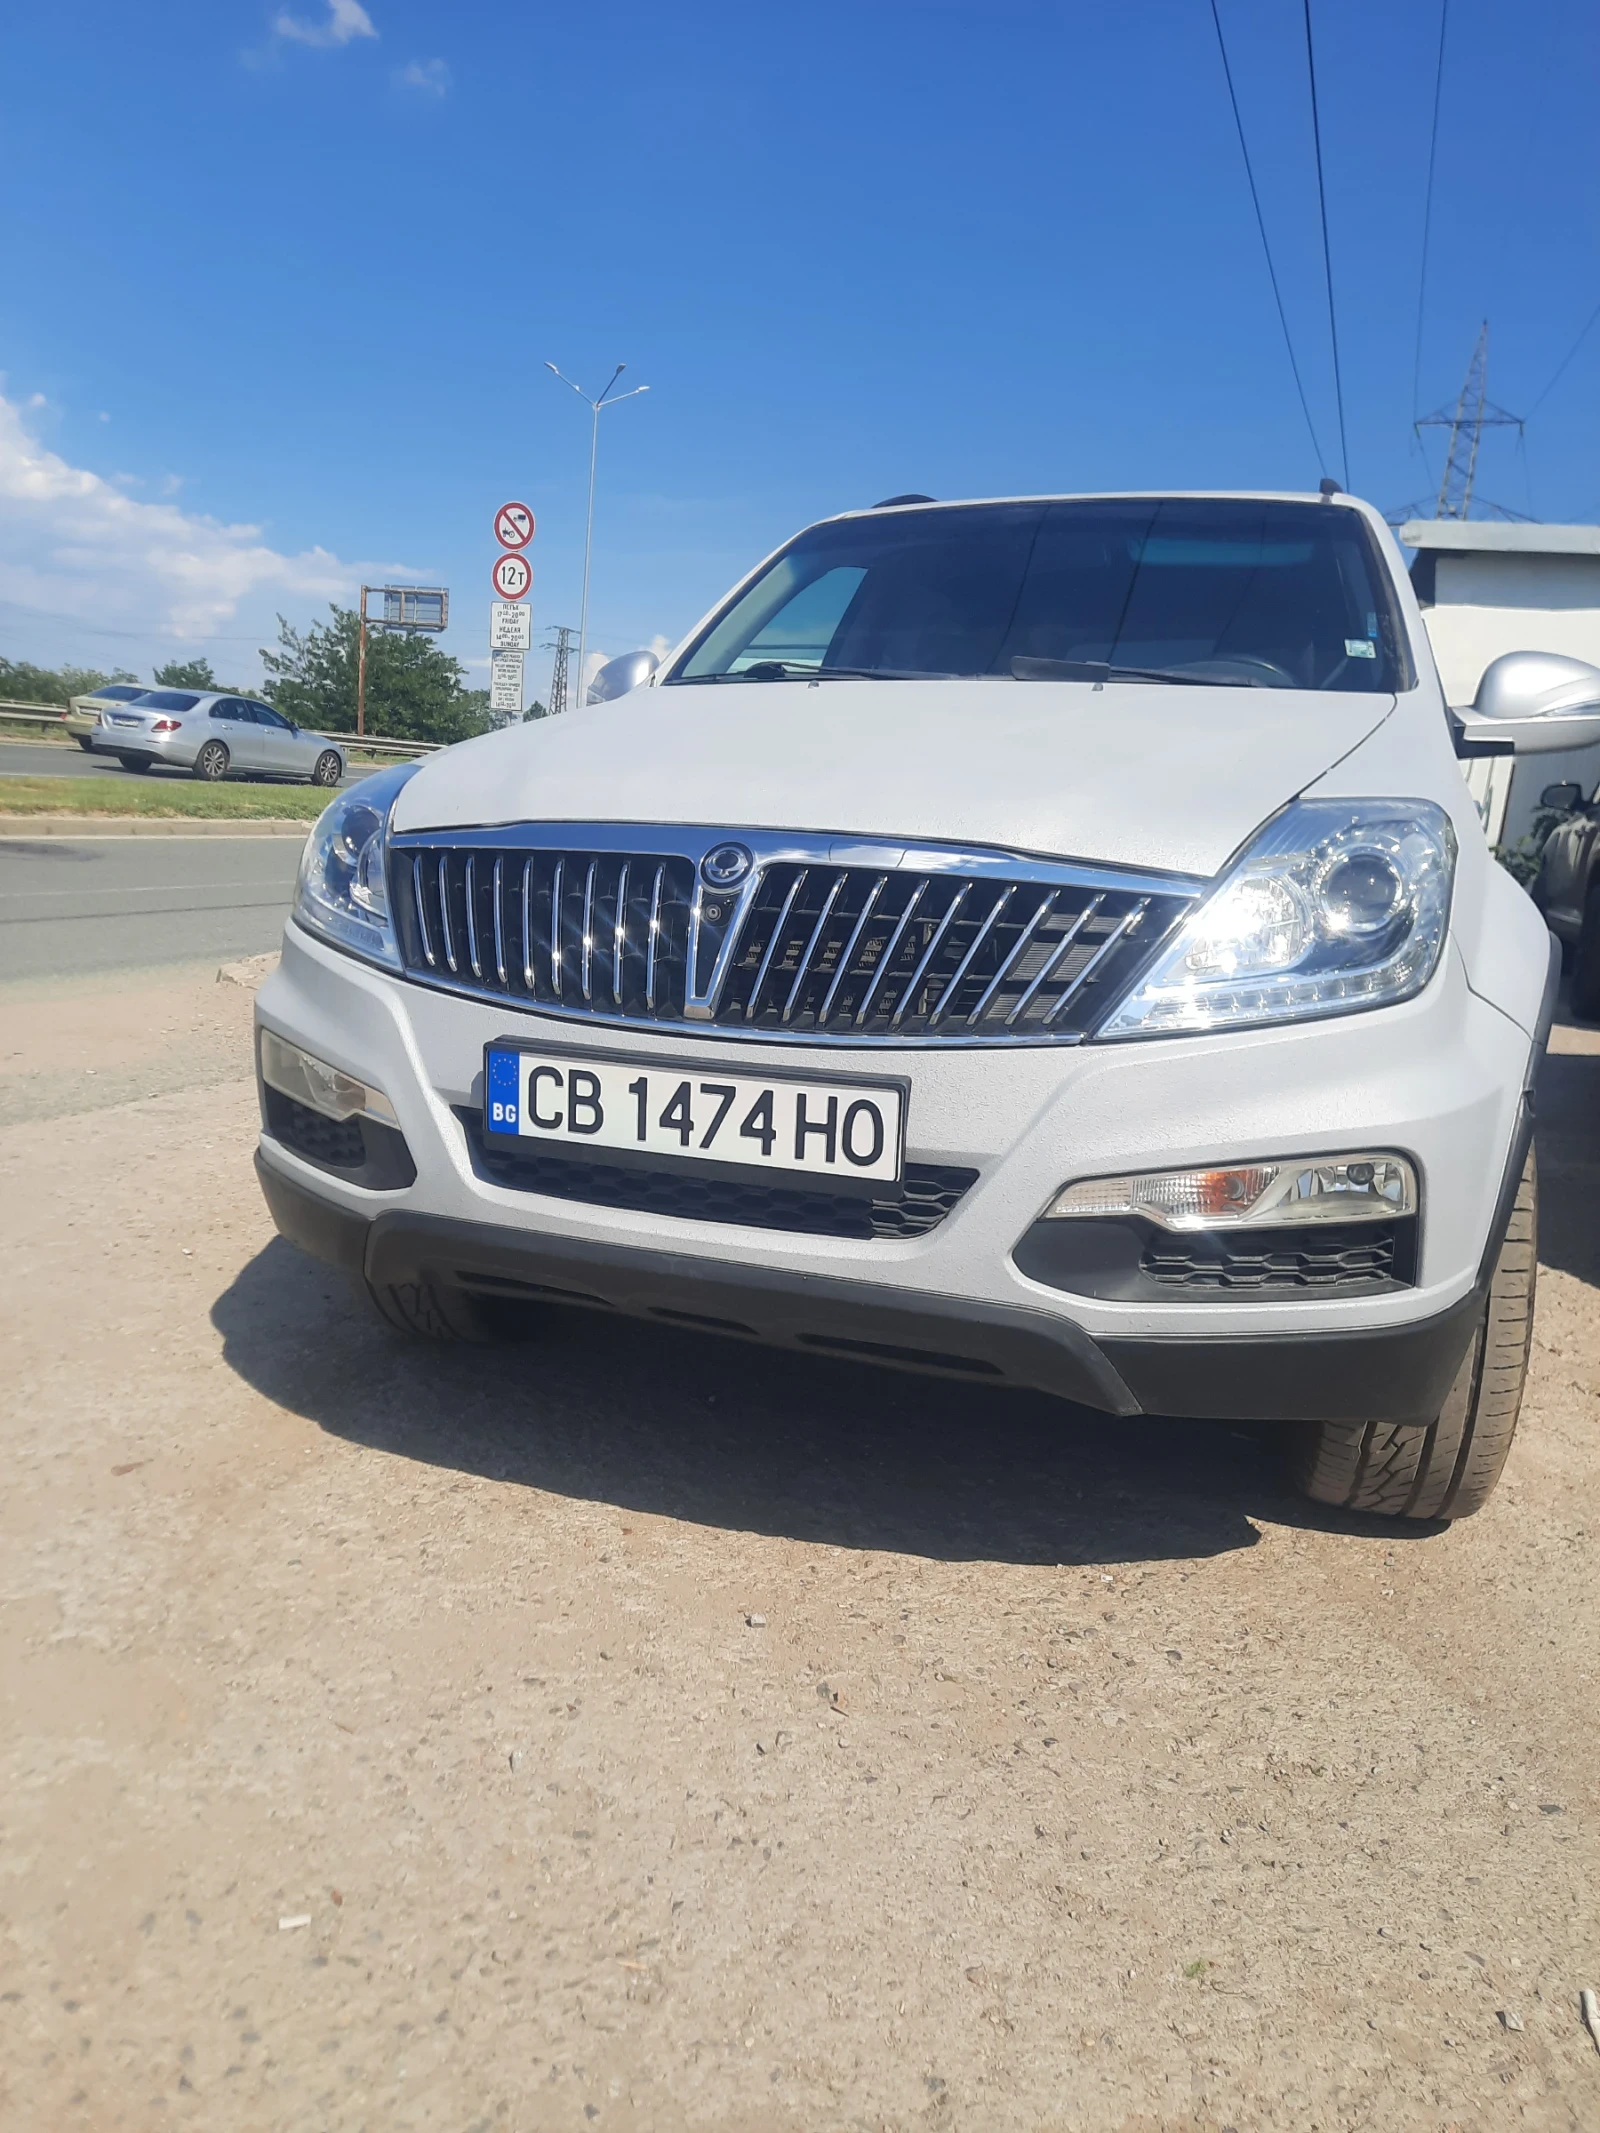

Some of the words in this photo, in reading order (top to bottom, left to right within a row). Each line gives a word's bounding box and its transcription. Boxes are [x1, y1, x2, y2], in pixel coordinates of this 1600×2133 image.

[493, 1102, 516, 1123] BG
[528, 1065, 604, 1134] CB
[629, 1077, 776, 1156] 1474
